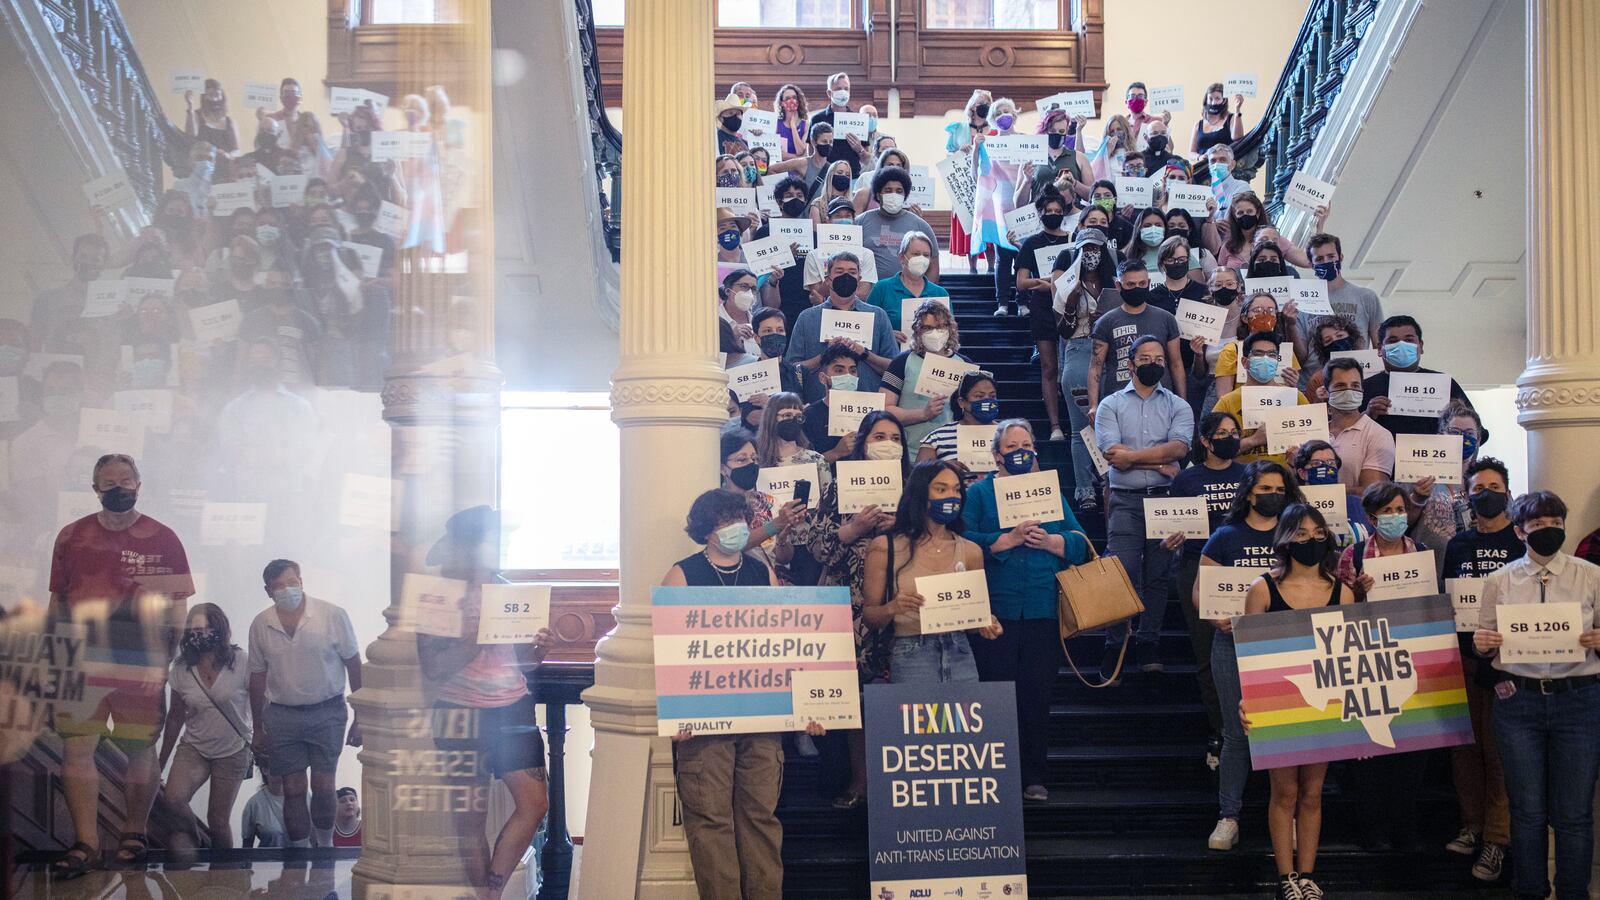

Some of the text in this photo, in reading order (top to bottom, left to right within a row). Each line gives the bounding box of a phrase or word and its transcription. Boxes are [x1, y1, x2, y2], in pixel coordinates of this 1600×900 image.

[1295, 181, 1326, 200] HB 4014
[1015, 212, 1036, 224] HB 22
[756, 245, 779, 257] SB 18
[1267, 286, 1288, 294] 1424
[1185, 311, 1216, 325] HB 217
[834, 321, 852, 329] HJR
[1115, 325, 1136, 336] THIS
[736, 370, 769, 384] SB 551
[931, 368, 945, 378] HB
[1404, 386, 1436, 394] HB 10
[1259, 398, 1273, 406] SB
[840, 404, 874, 414] HB 187
[1281, 419, 1312, 428] SB 39
[1412, 449, 1447, 458] HB 26
[769, 481, 790, 490] HJR
[850, 476, 890, 485] HB 100
[1203, 482, 1241, 491] TEXAS
[1005, 486, 1052, 501] HB 1458
[1207, 502, 1233, 511] ETW
[1314, 500, 1334, 509] 369
[1172, 508, 1199, 516] 1148
[1383, 569, 1419, 582] HB 25
[1217, 583, 1233, 592] SB
[937, 589, 971, 602] SB 28
[1459, 595, 1477, 604] HB
[504, 603, 530, 613] SB 2
[685, 608, 824, 631] #LetKidsPlay
[1510, 621, 1570, 633] SB 1206
[1315, 620, 1398, 655] Y'ALL
[687, 638, 826, 661] #LetKidsPlay
[1313, 649, 1412, 689] MEANS
[810, 688, 843, 698] SB 29
[1342, 685, 1399, 720] ALL
[900, 702, 984, 735] TEXANS
[678, 720, 733, 732] EQUALITY
[882, 742, 1007, 774] DESERVE
[891, 777, 1000, 808] BETTER
[896, 826, 997, 844] UNITED AGAINST
[875, 845, 1020, 865] ANTI-TRANS LEGISLATION
[909, 889, 931, 898] ACLU
